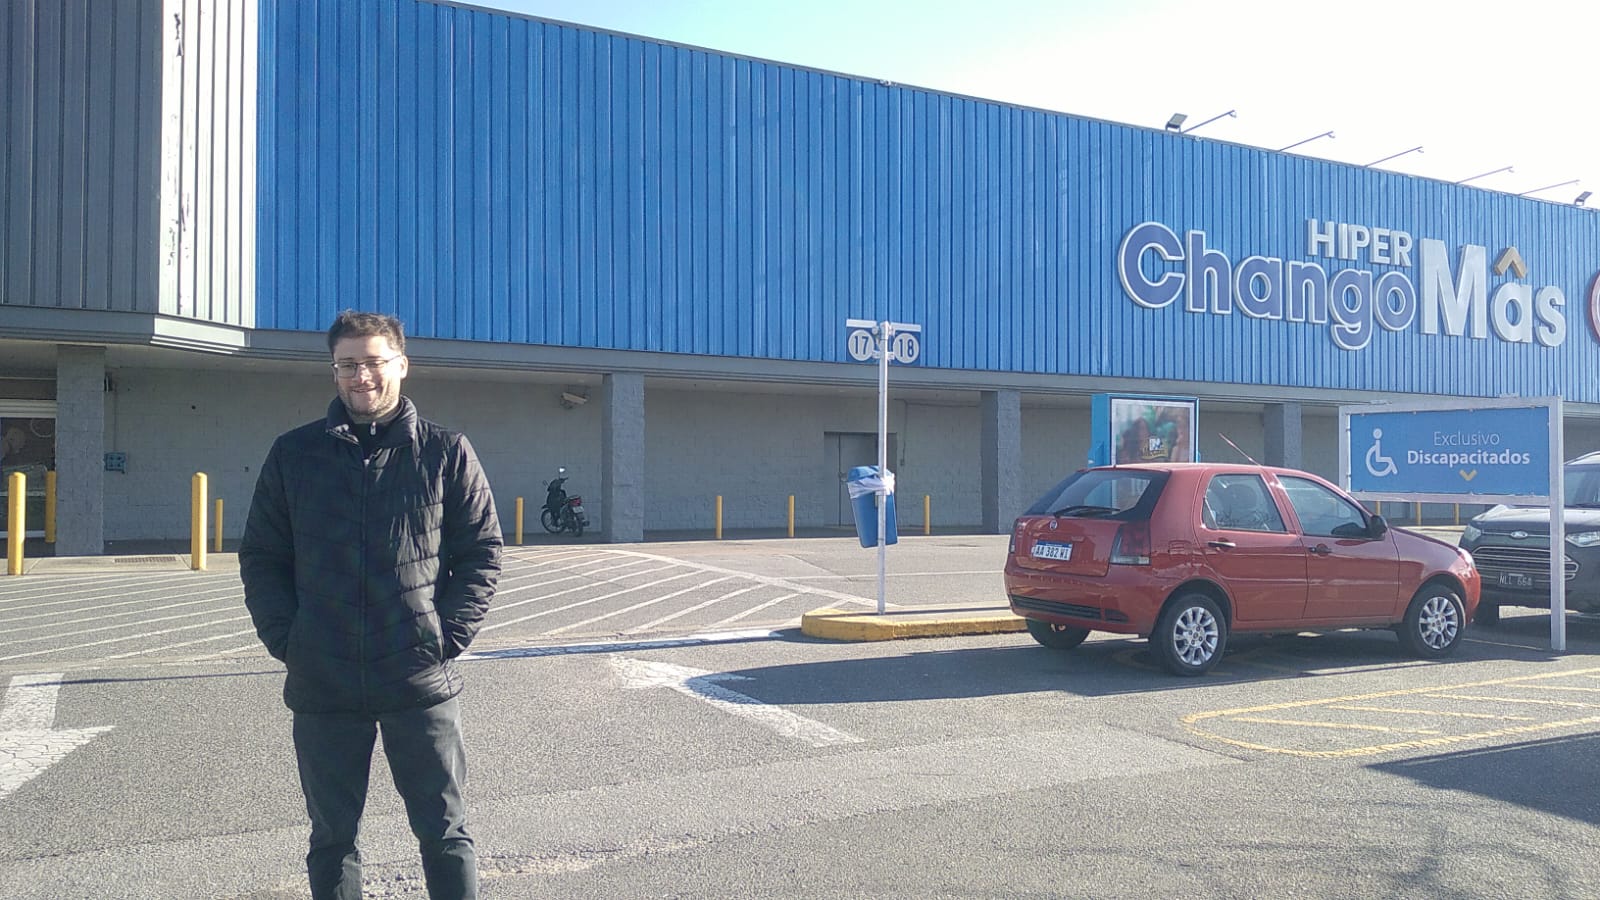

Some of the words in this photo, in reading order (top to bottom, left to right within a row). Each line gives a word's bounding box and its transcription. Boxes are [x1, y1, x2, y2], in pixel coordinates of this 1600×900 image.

[1306, 218, 1413, 267] HIPER
[854, 335, 869, 355] 17
[899, 339, 914, 358] 18
[1434, 430, 1500, 446] Exclusivo
[1407, 449, 1530, 468] Discapacitados
